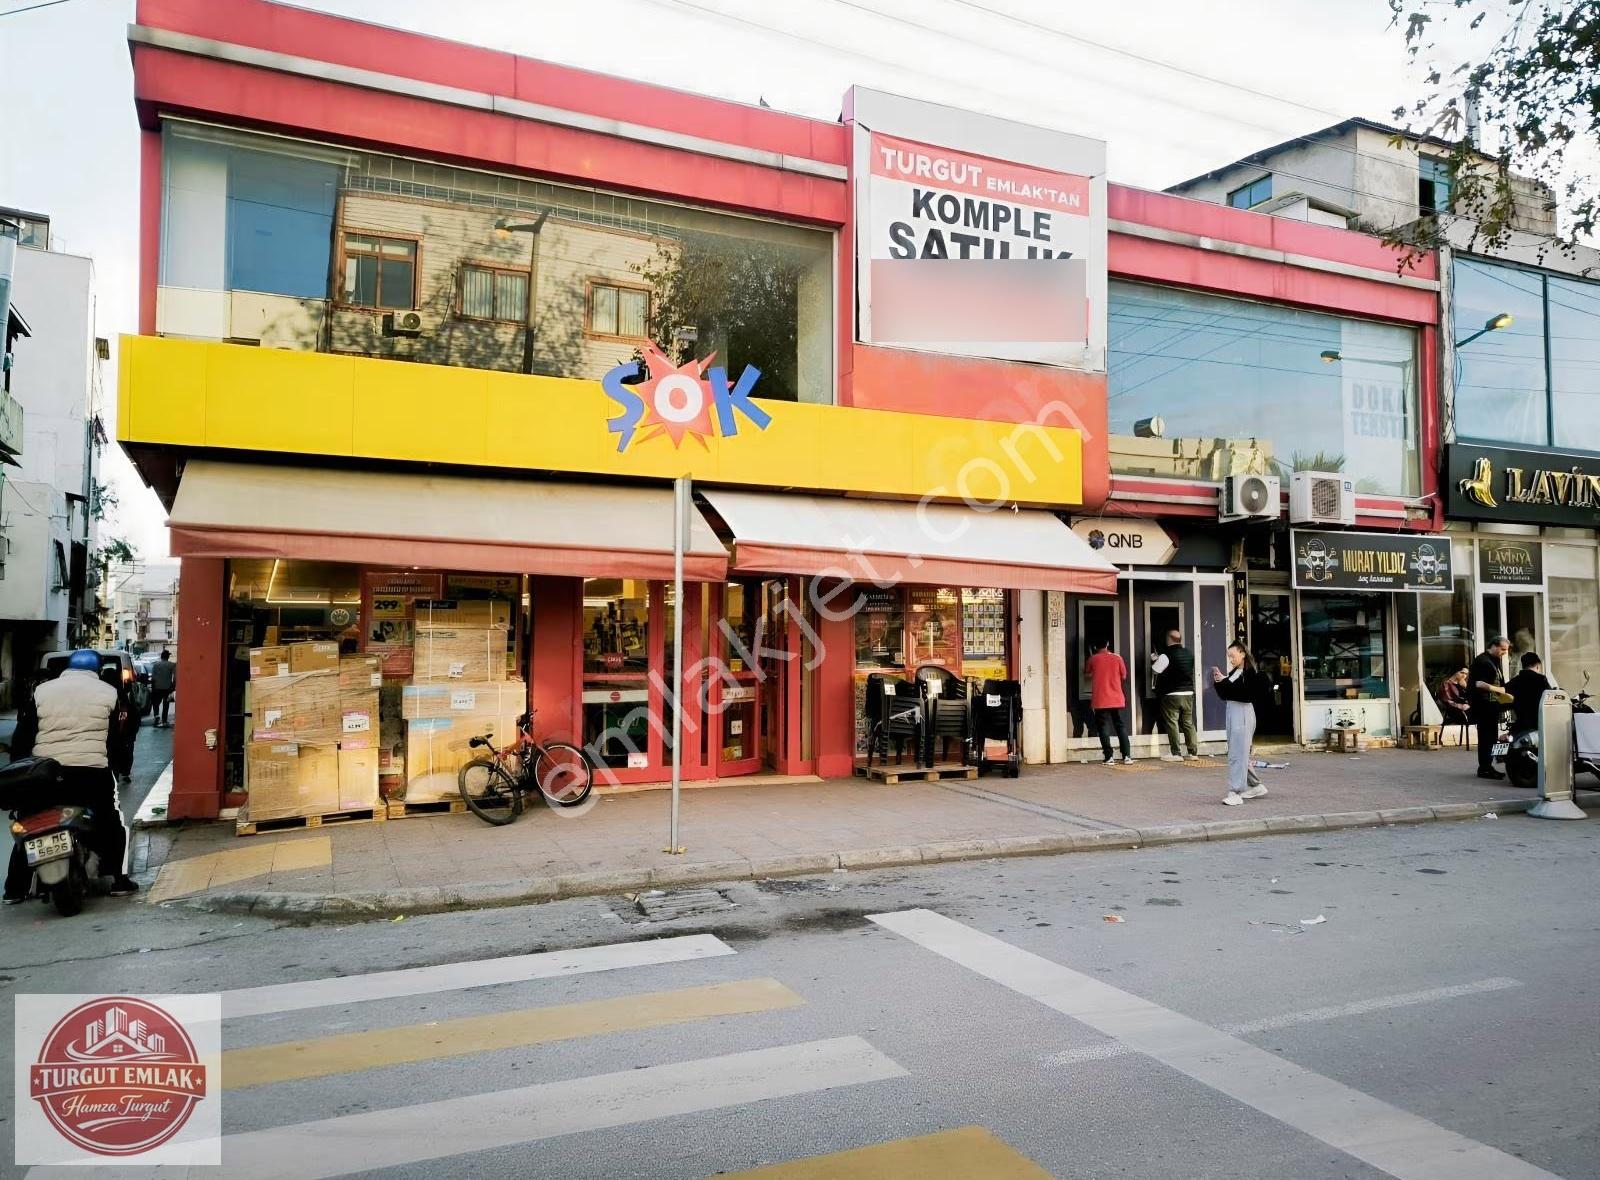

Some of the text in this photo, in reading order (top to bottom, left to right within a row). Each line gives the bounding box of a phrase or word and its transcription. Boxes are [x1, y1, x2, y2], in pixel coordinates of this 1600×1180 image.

[881, 147, 1080, 208] TURGUT EMLAK'TAN
[912, 188, 1051, 242] KOMPLE
[602, 361, 772, 453] ŞOK
[1107, 533, 1143, 549] QNB
[1342, 550, 1407, 575] MURAT YILDIZ
[1500, 566, 1524, 575] MODA
